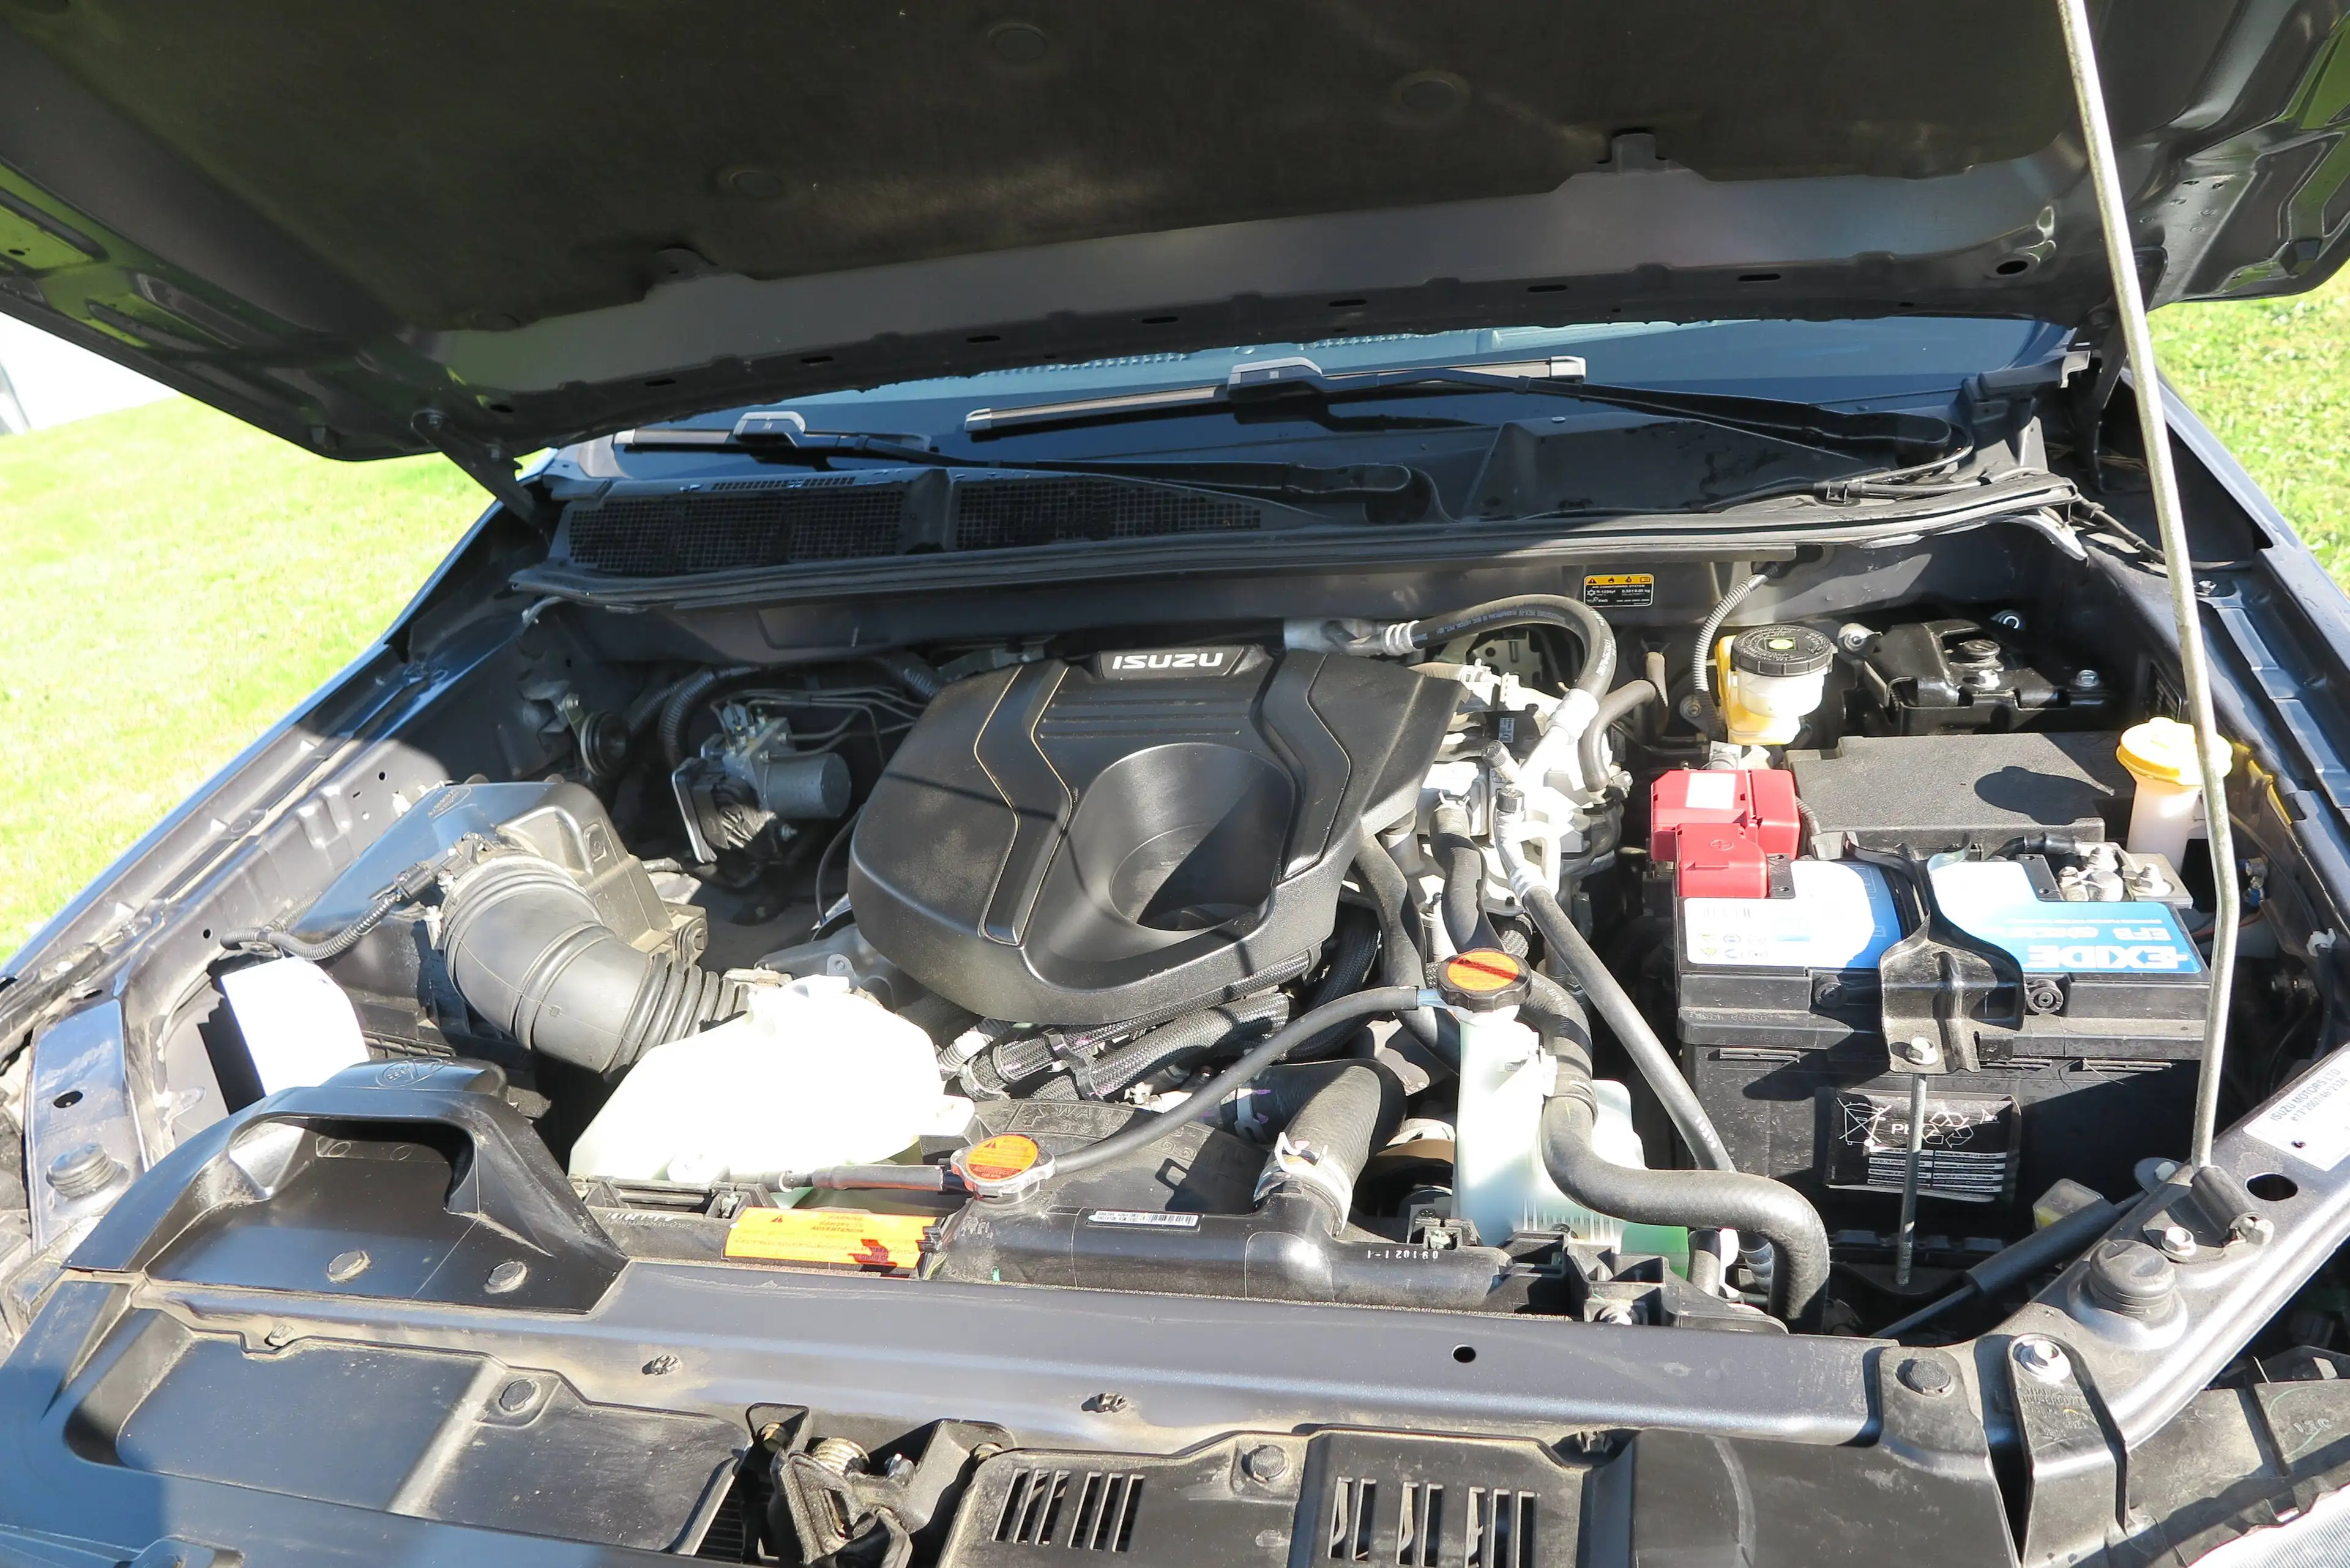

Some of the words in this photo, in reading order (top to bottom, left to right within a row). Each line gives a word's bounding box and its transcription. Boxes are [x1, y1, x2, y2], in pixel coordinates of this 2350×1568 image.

[1111, 652, 1223, 670] ISUZU
[2113, 927, 2173, 941] EFB
[2027, 944, 2186, 969] EXIDE
[2269, 1101, 2296, 1121] ISUZU
[2291, 1079, 2327, 1103] MOTORS
[2324, 1069, 2341, 1081] LTD
